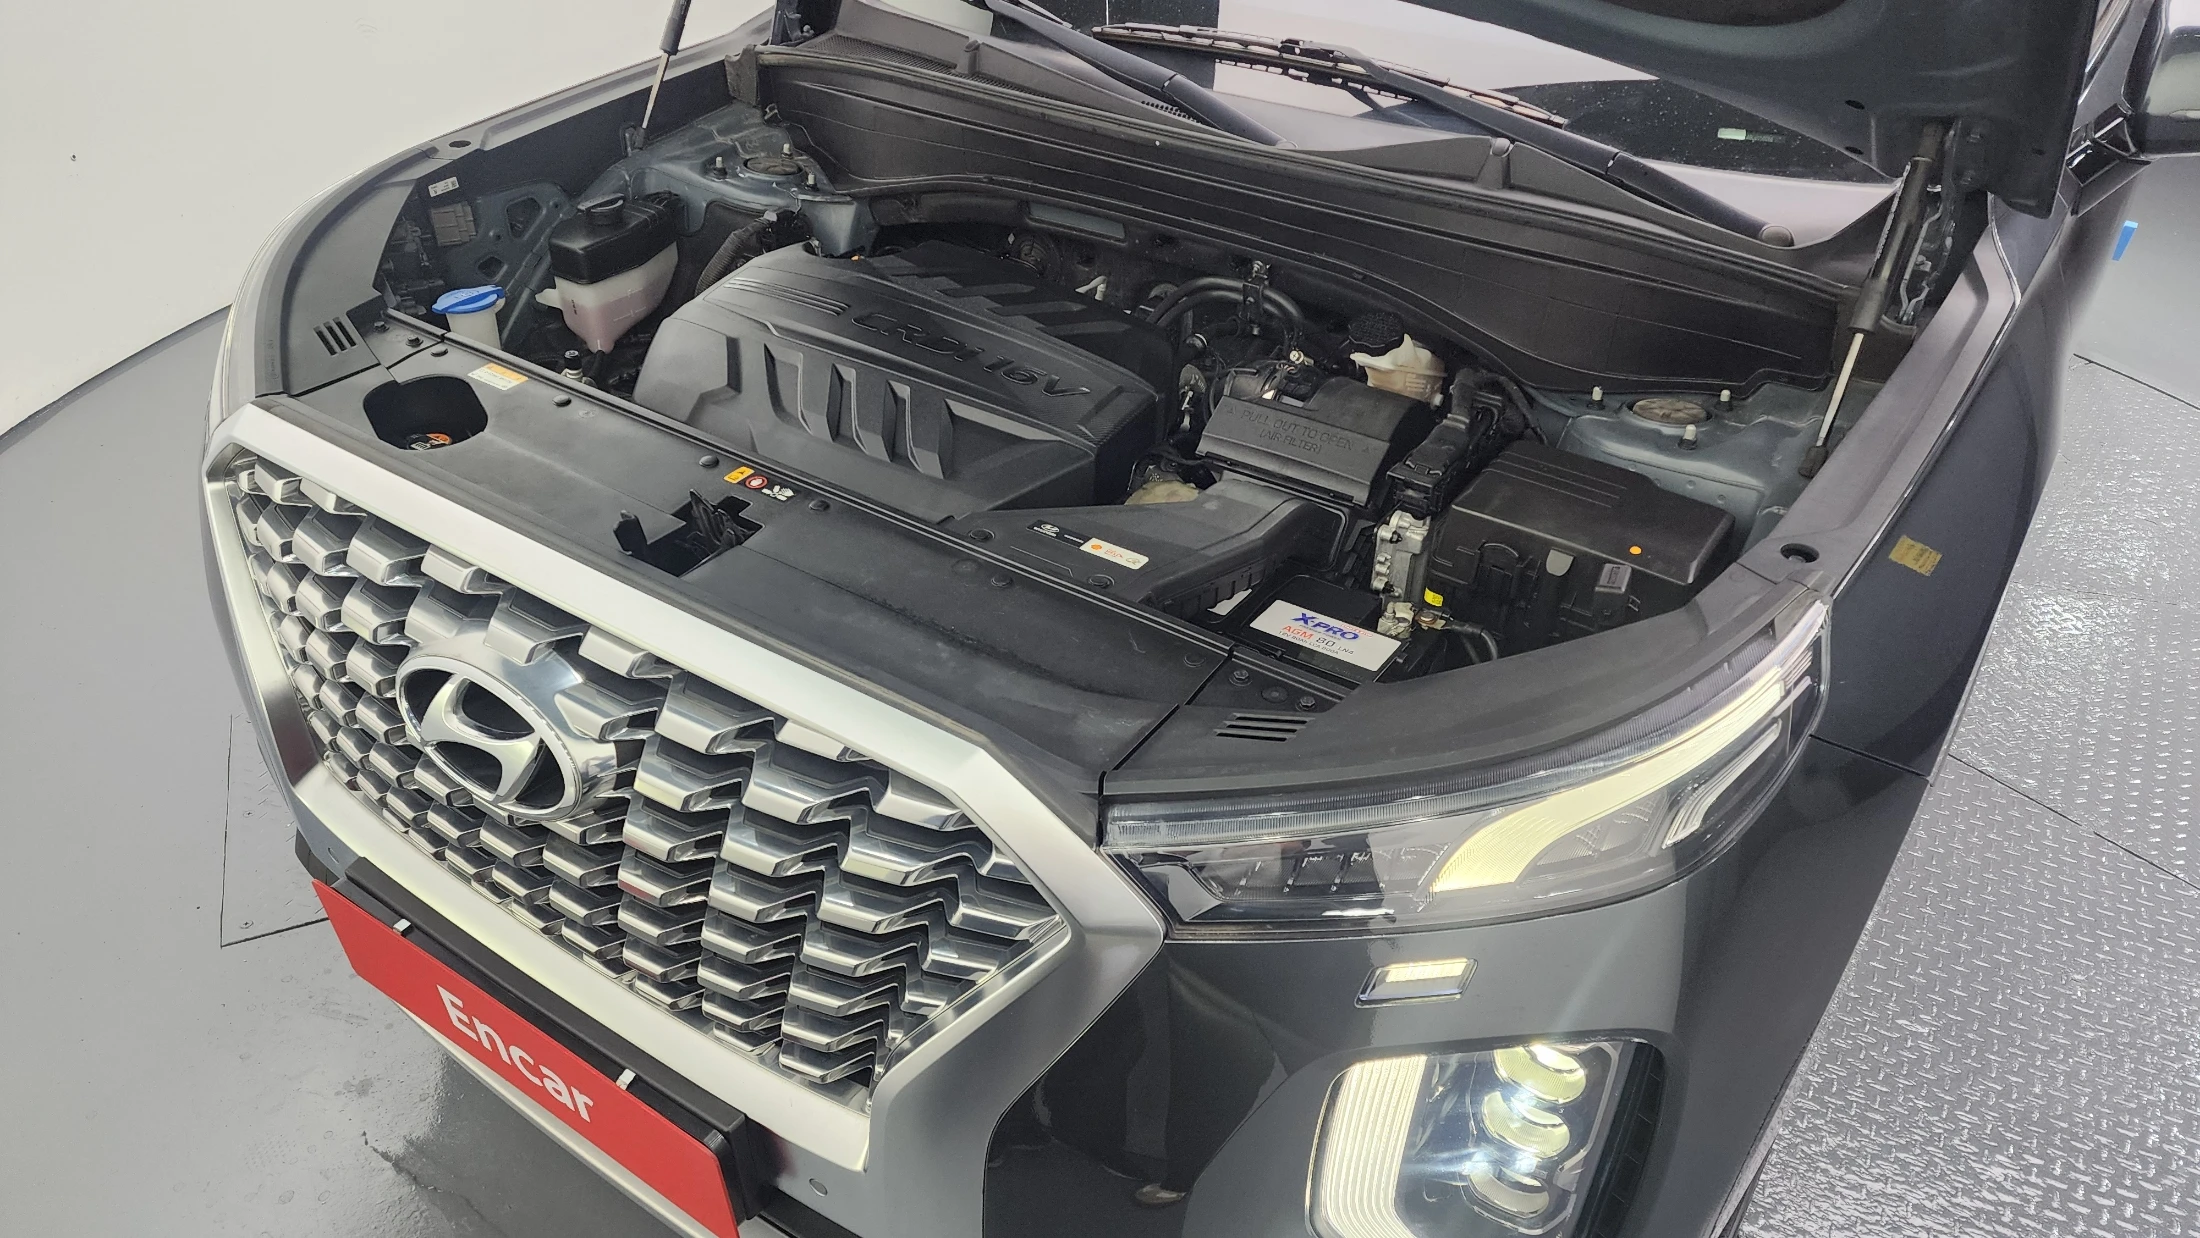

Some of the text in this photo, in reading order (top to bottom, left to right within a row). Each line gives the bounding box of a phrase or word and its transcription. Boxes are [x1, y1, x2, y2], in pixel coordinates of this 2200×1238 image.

[983, 355, 1091, 397] 16V
[1240, 408, 1355, 451] PULL OUT TO OPEN
[1282, 624, 1315, 640] AGM
[1316, 636, 1336, 648] 80
[1292, 612, 1360, 640] X-PRO
[436, 984, 594, 1123] Encar
